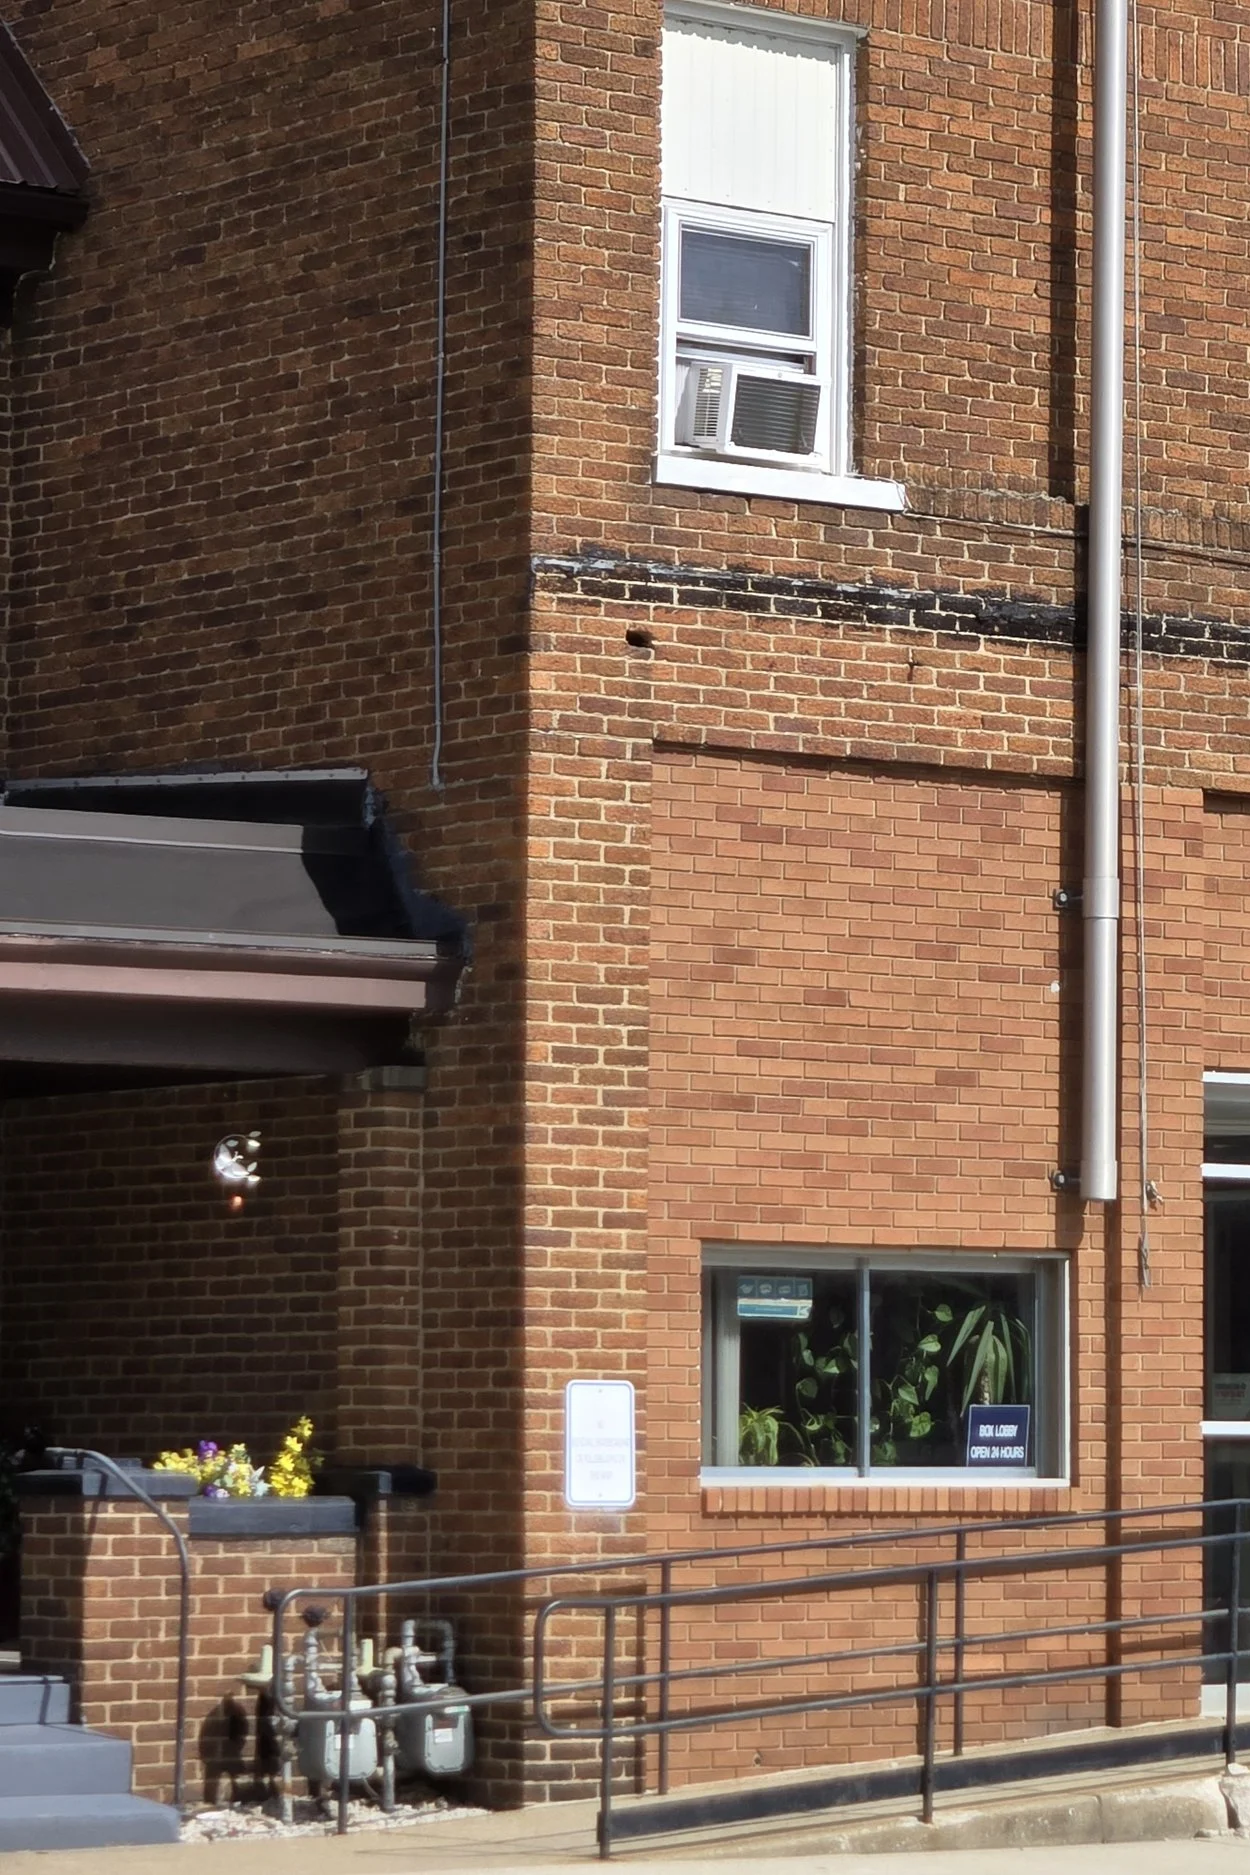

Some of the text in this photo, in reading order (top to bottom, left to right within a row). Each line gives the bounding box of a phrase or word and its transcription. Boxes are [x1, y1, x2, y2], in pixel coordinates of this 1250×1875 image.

[979, 1424, 1018, 1437] BOX LOBBY
[970, 1446, 1024, 1459] OPEN 24 HOURS
